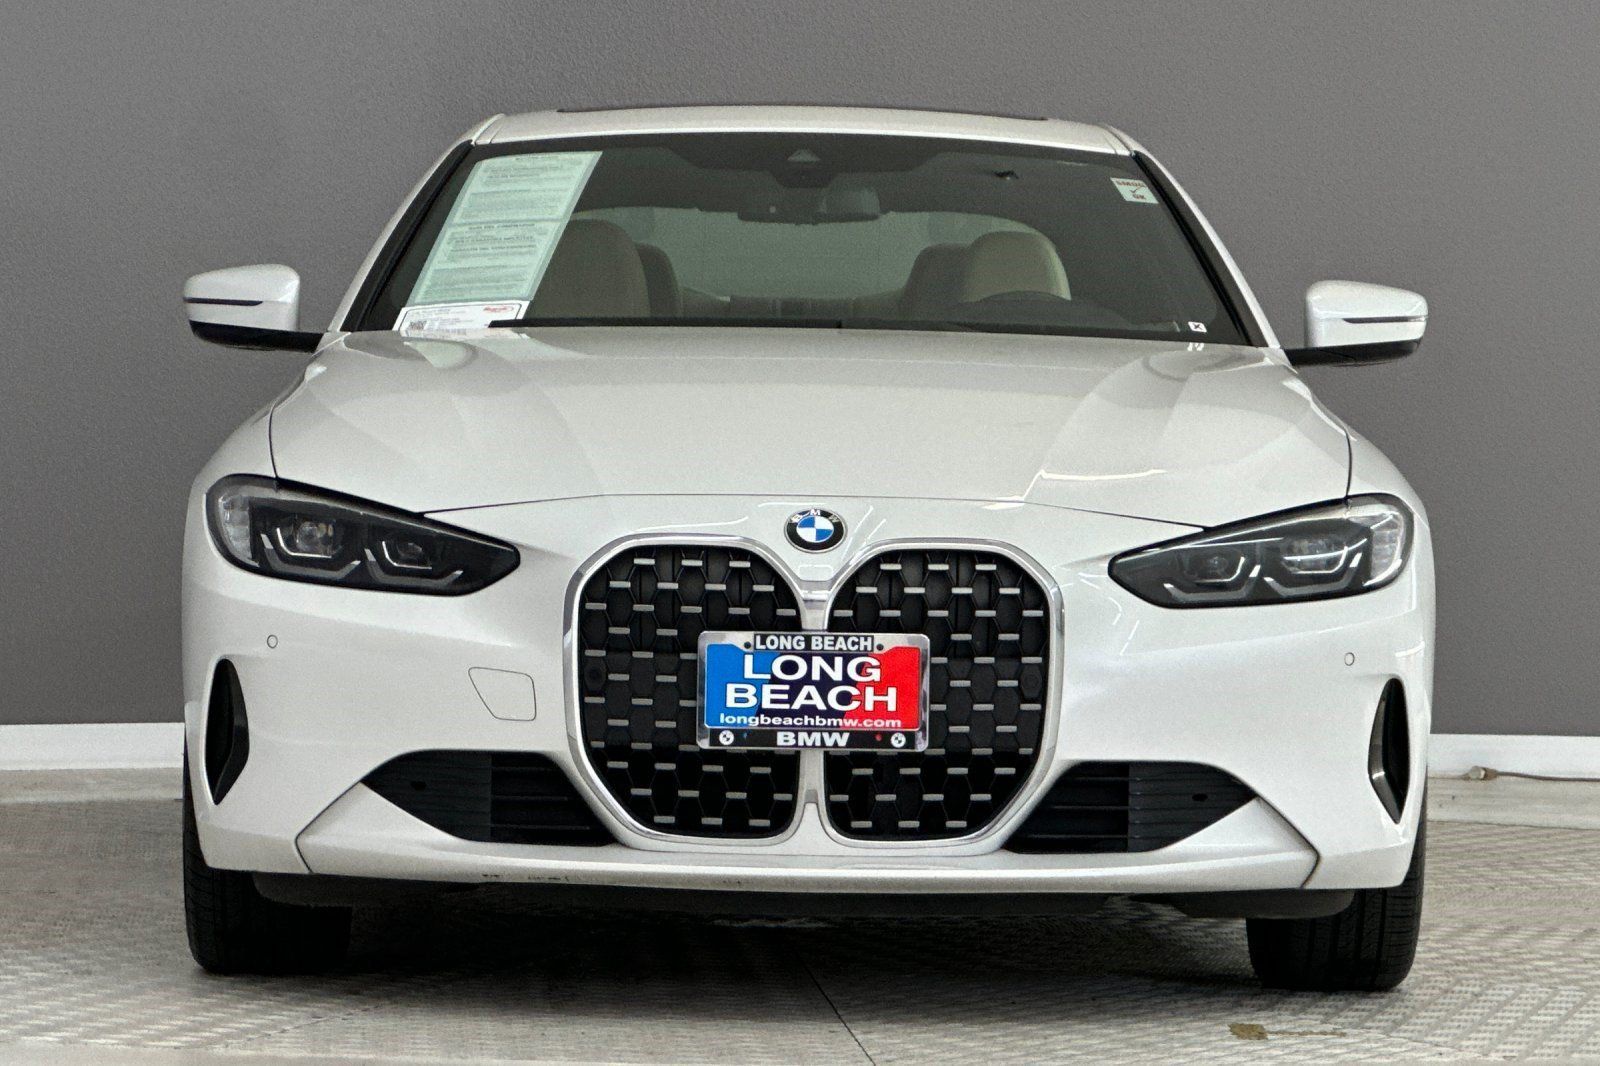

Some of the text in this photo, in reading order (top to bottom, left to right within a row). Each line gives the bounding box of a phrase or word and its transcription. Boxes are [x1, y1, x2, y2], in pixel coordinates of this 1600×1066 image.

[755, 635, 872, 652] LONG BEACH
[743, 654, 881, 682] LONG
[725, 683, 897, 712] BEACH
[719, 713, 902, 728] longbeachbmw.com
[776, 731, 850, 747] BMW
